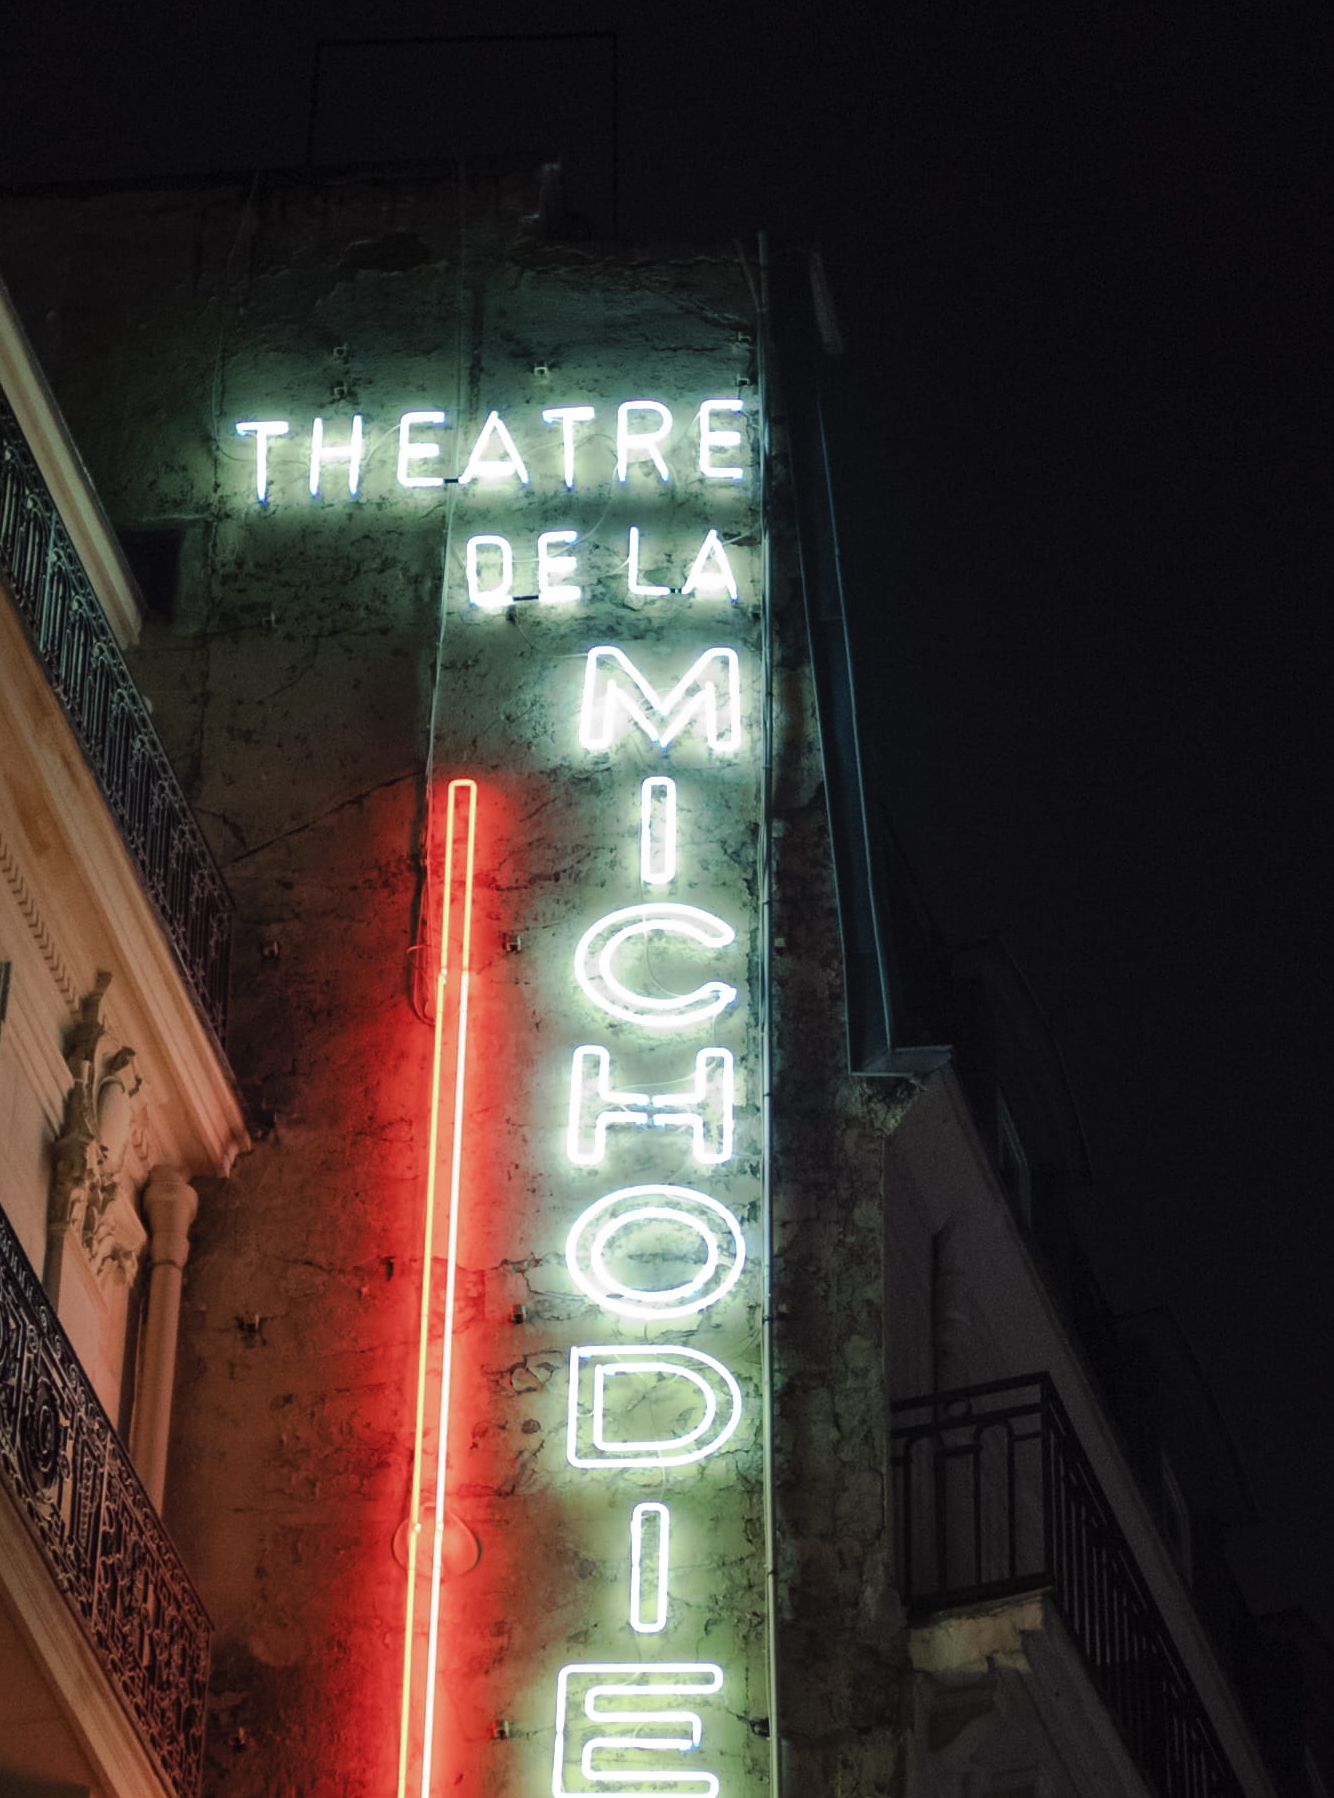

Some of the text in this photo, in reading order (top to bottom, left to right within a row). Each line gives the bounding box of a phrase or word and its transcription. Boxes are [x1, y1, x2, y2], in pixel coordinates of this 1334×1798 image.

[235, 398, 744, 502] THEATRE
[466, 526, 739, 607] DE LA
